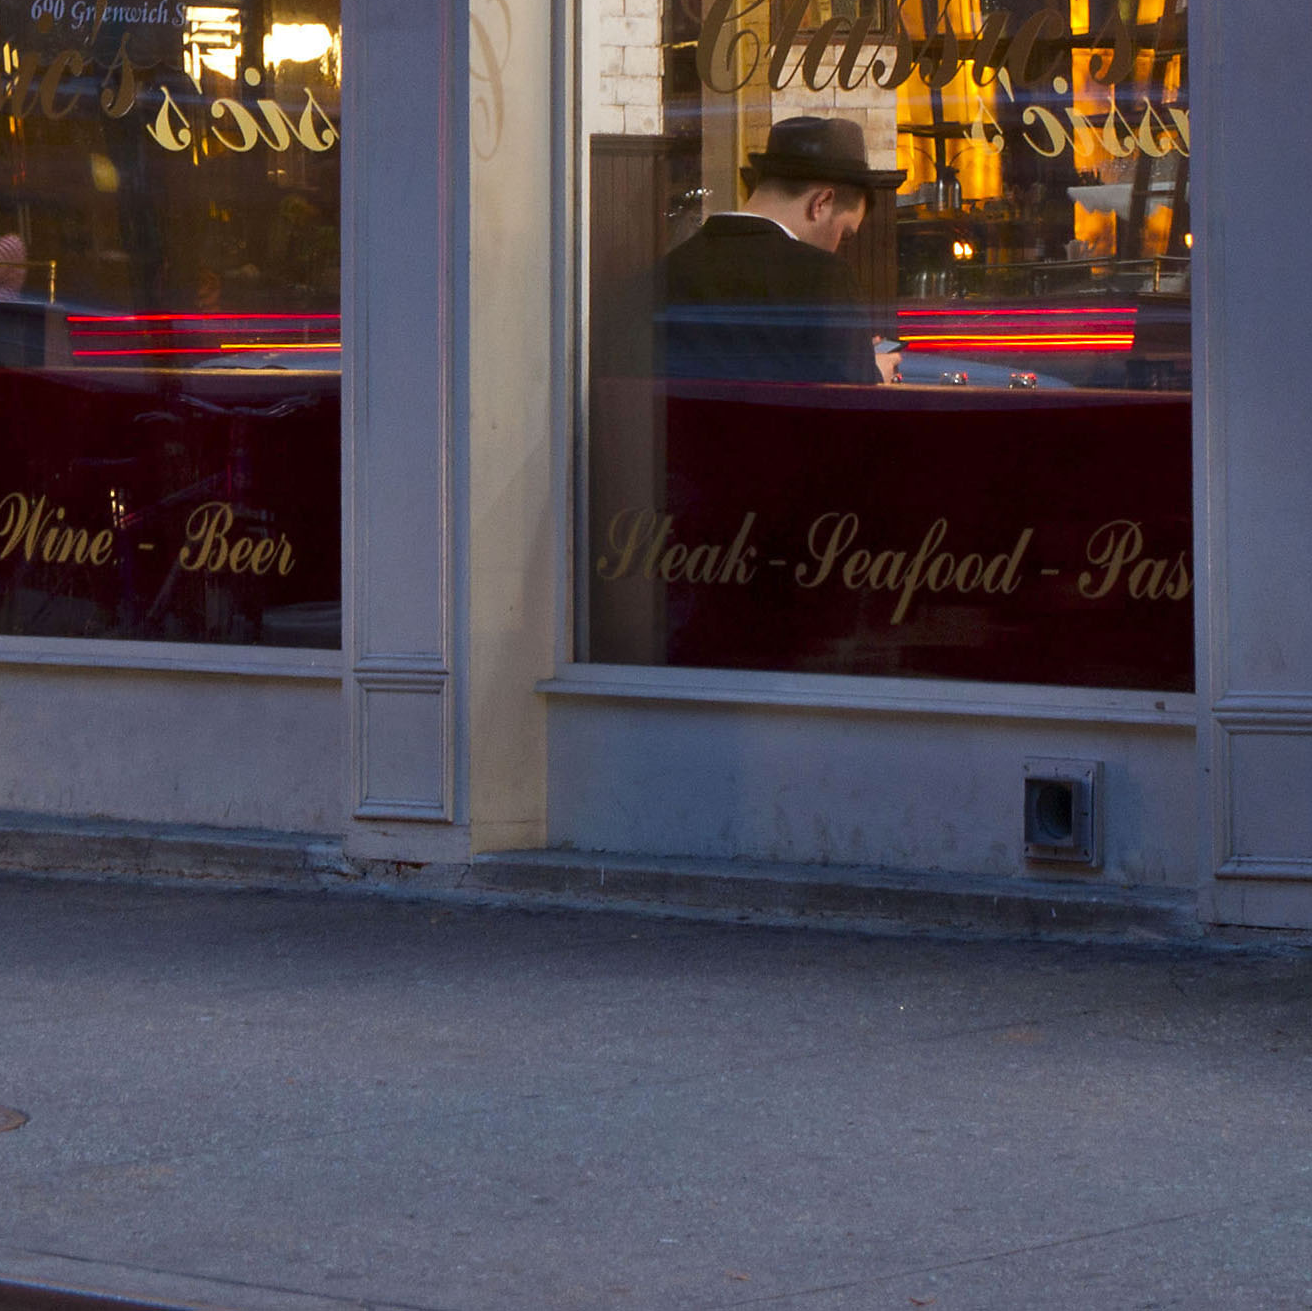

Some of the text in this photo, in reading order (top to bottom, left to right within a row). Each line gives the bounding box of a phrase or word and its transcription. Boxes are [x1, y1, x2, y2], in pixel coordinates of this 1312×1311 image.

[178, 500, 297, 578] Beer
[596, 511, 759, 586] Steak
[794, 510, 1035, 625] Seafood
